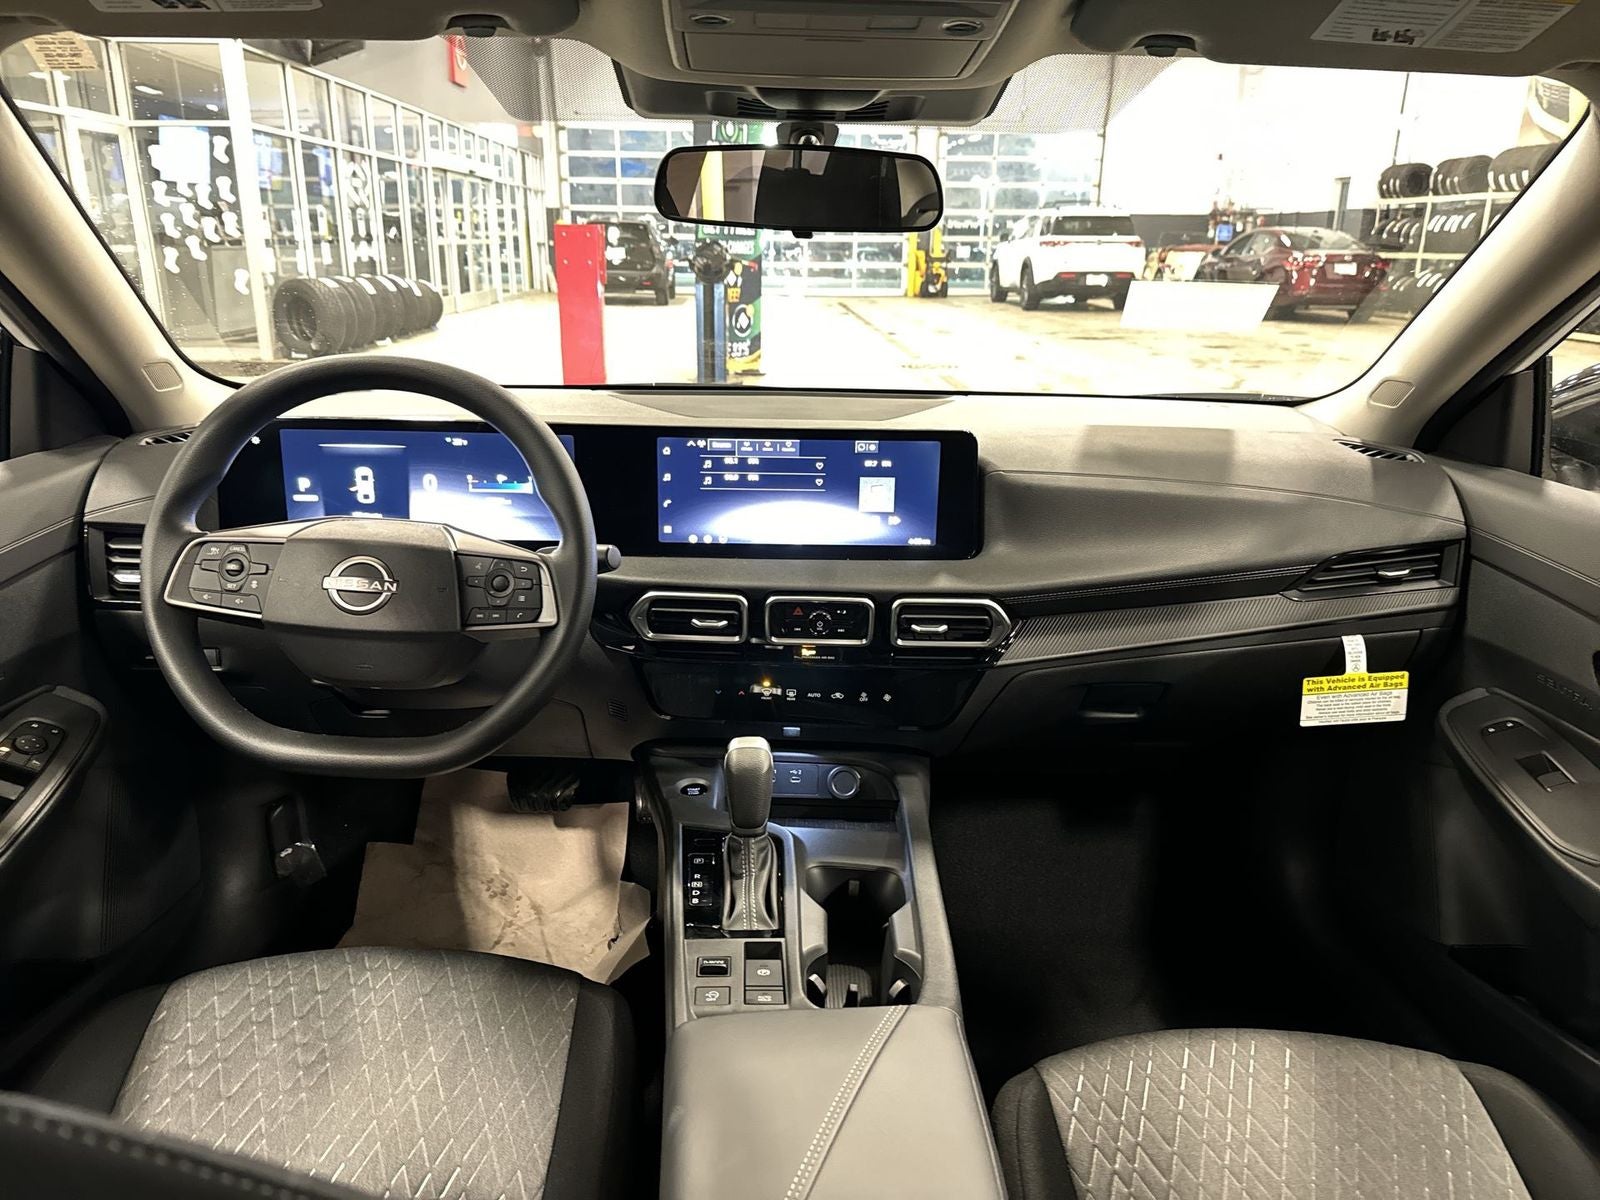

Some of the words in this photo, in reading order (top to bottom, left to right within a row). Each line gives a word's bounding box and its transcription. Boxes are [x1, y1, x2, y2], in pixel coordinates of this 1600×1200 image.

[297, 477, 311, 492] P
[1326, 676, 1356, 684] Vehicle
[1368, 673, 1405, 682] Equipped
[1306, 685, 1325, 693] with
[1327, 682, 1367, 692] Advanced
[1383, 681, 1404, 689] Bags
